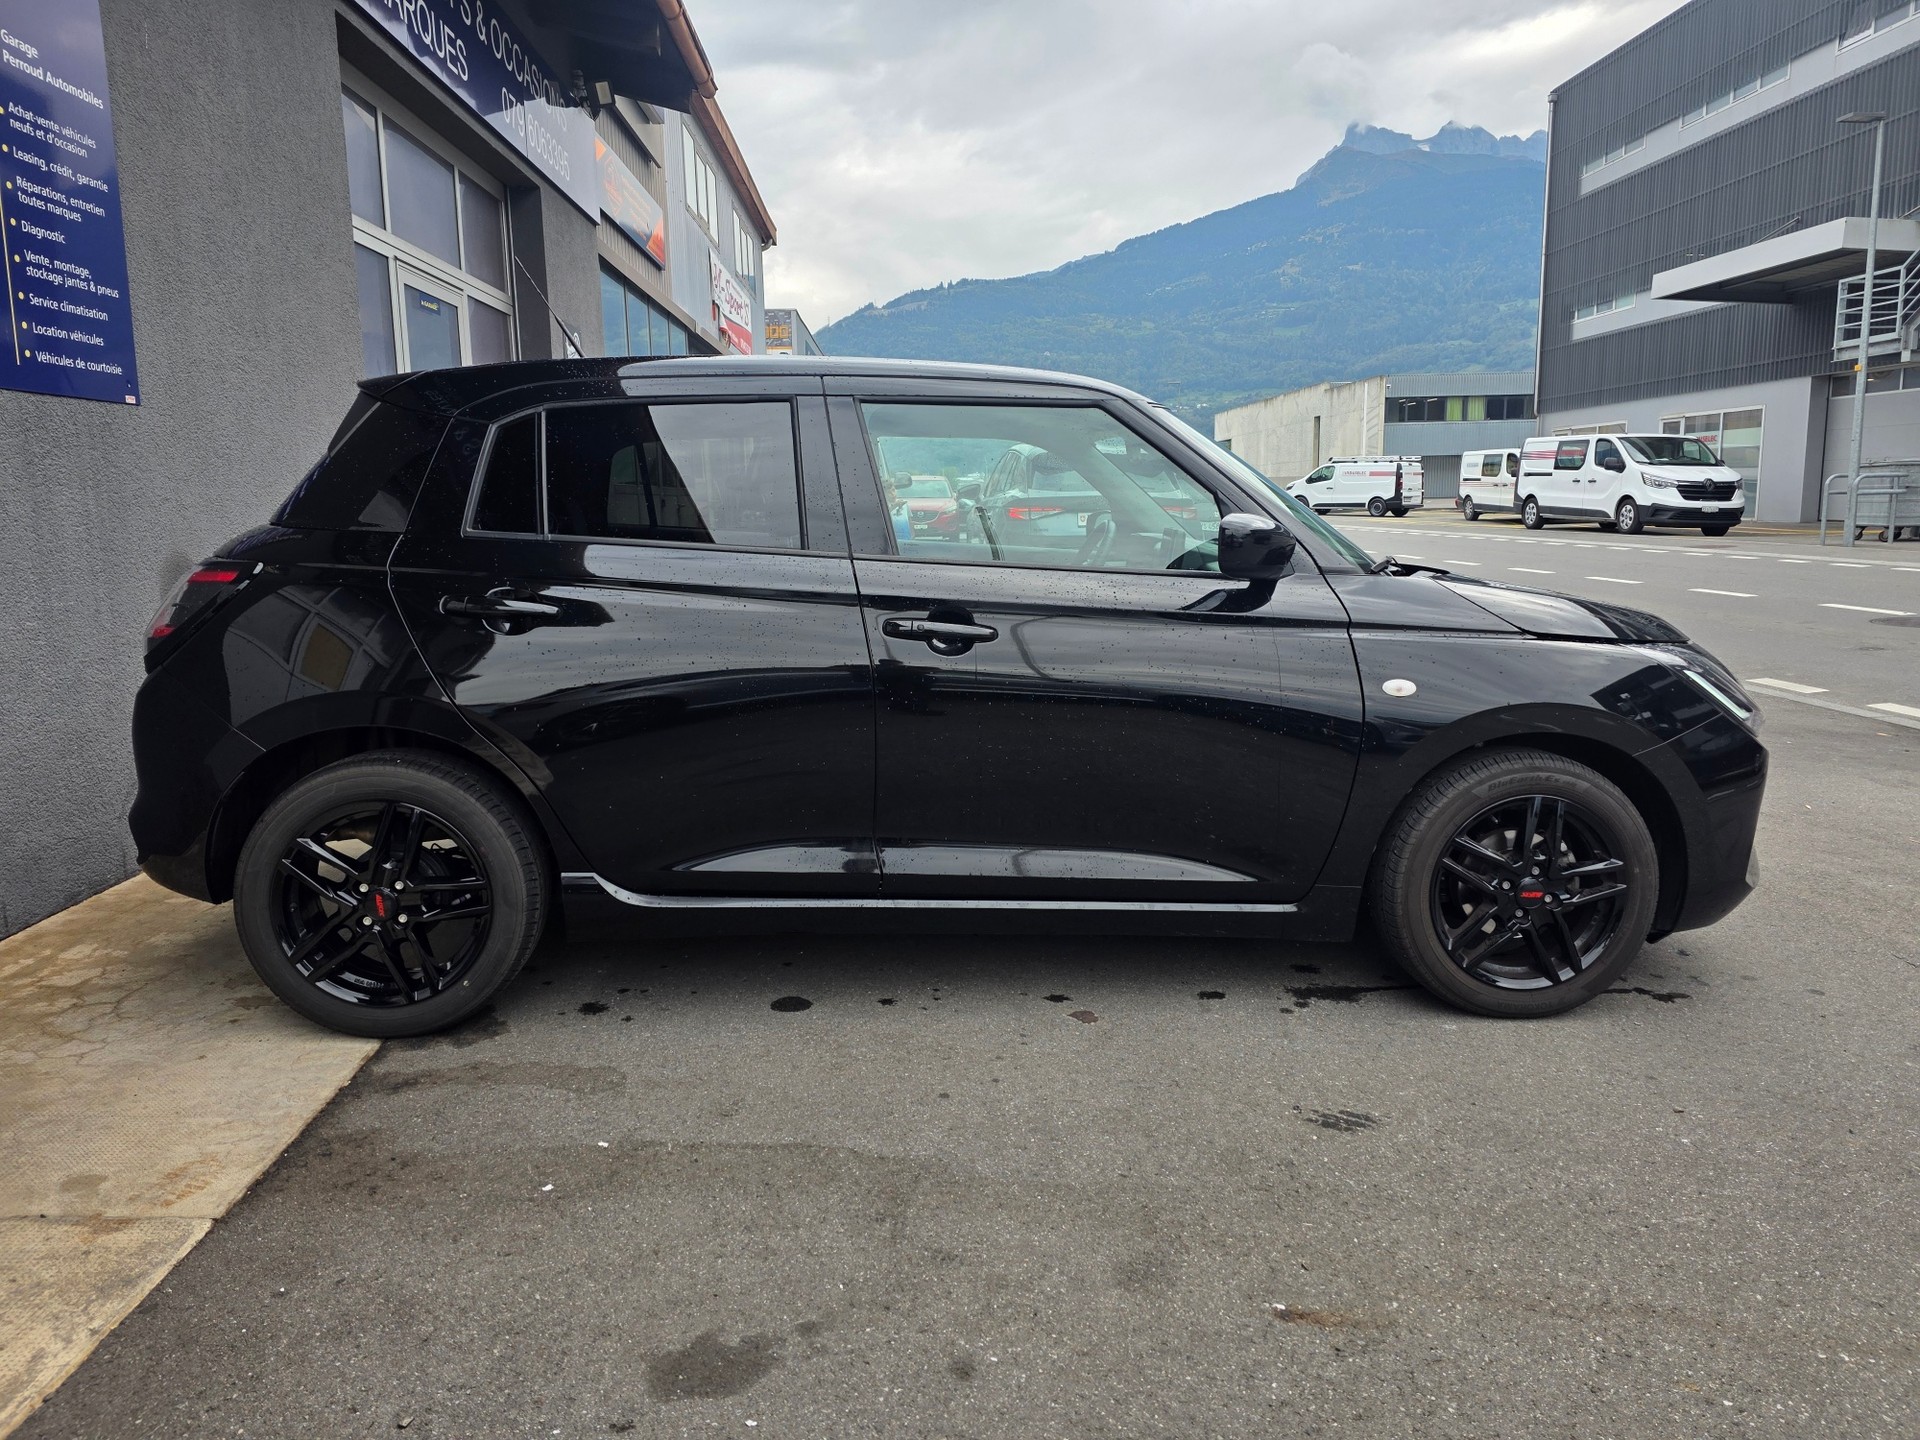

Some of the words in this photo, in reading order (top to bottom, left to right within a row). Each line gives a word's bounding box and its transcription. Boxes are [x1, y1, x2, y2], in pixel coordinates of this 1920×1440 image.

[1, 29, 39, 59] Garage
[3, 49, 43, 81] Perroud
[46, 72, 104, 109] Automobiles
[476, 1, 488, 45] &
[490, 18, 567, 132] OCCASIONS
[8, 101, 60, 133] Achat-vente
[61, 126, 96, 149] véhicules
[501, 86, 525, 137] 079
[9, 118, 35, 138] neufs
[36, 129, 45, 140] et
[46, 132, 88, 158] d'occasion
[13, 147, 48, 171] Leasing,
[50, 162, 75, 182] crédit,
[76, 173, 108, 193] garantie
[16, 176, 68, 206] Réparations,
[70, 196, 105, 217] entretien
[18, 191, 46, 210] toutes
[47, 204, 82, 223] marques
[21, 220, 66, 244] Diagnostic
[24, 249, 52, 268] Vente,
[54, 260, 92, 280] montage,
[26, 266, 63, 286] stockage
[64, 276, 88, 291] jantes
[89, 281, 96, 292] &
[97, 285, 119, 299] pneus
[29, 293, 59, 310] Service
[61, 300, 108, 321] climatisation
[32, 322, 68, 340] Location
[69, 330, 104, 346] véhicules
[35, 350, 74, 368] Véhicules
[75, 357, 86, 369] de
[87, 361, 122, 376] courtoisie
